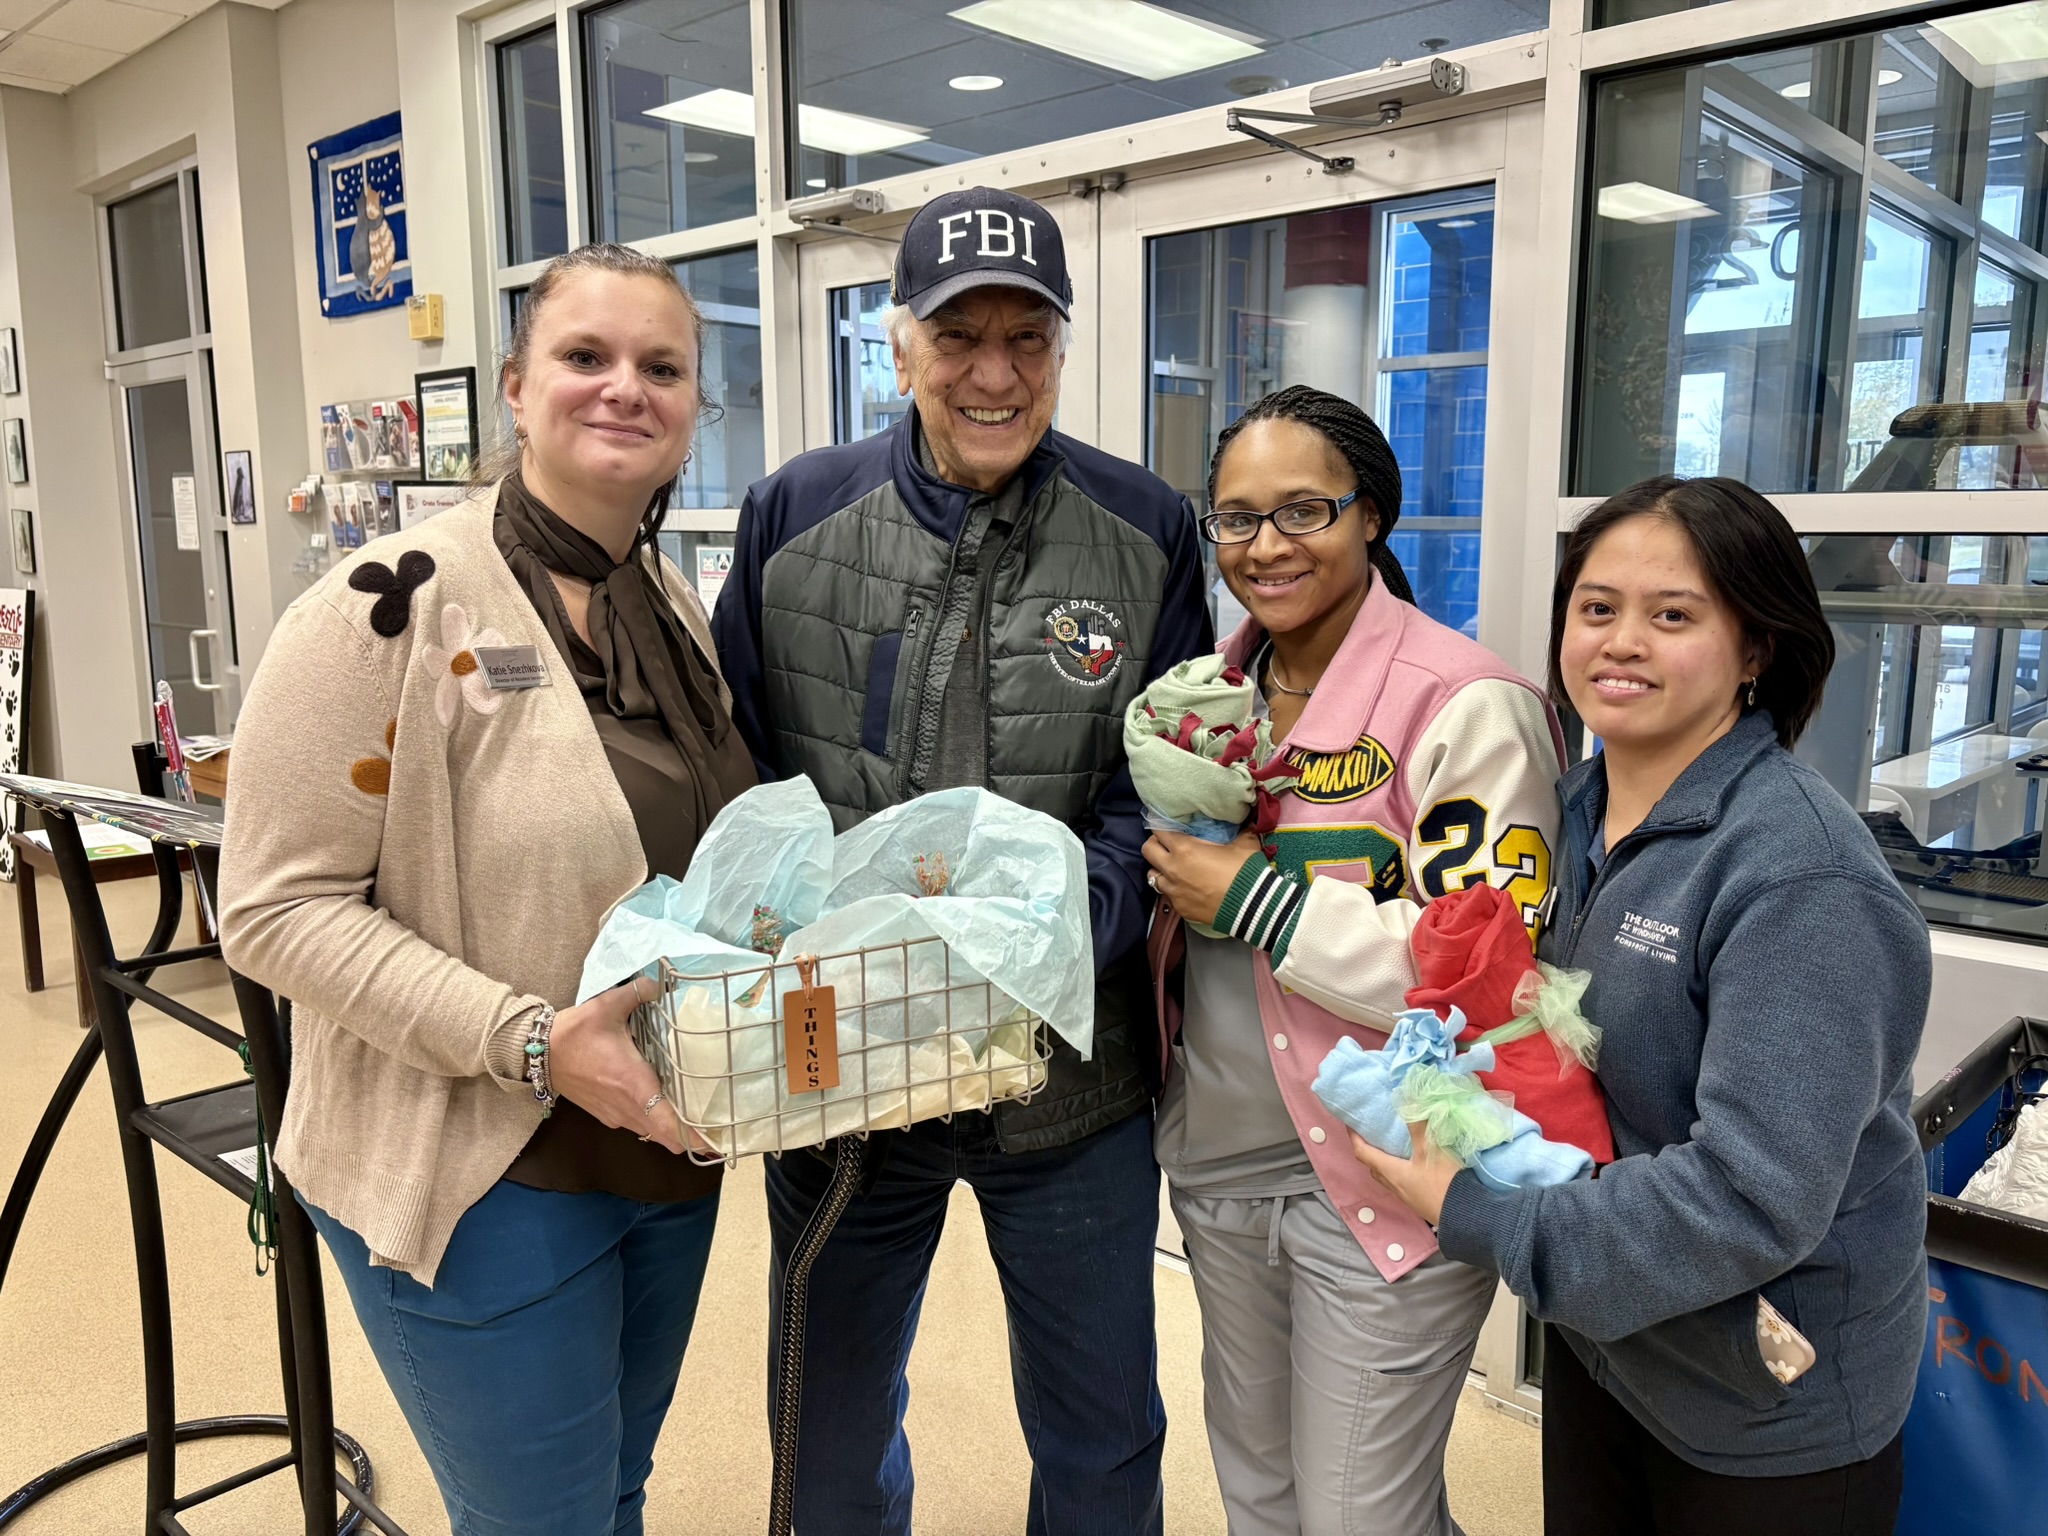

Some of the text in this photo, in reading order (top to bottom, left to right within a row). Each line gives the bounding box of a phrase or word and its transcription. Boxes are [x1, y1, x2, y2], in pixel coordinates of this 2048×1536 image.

[938, 209, 1037, 266] FBI
[1045, 599, 1122, 629] FBI DALLAS
[486, 662, 546, 676] Katie Snezhkova
[1074, 676, 1096, 687] TEXAS
[1620, 922, 1667, 944] AT WINDHAVEN
[1624, 911, 1680, 938] THE OUTLOOK
[1650, 948, 1677, 963] LIVING
[804, 1007, 819, 1088] THINGS
